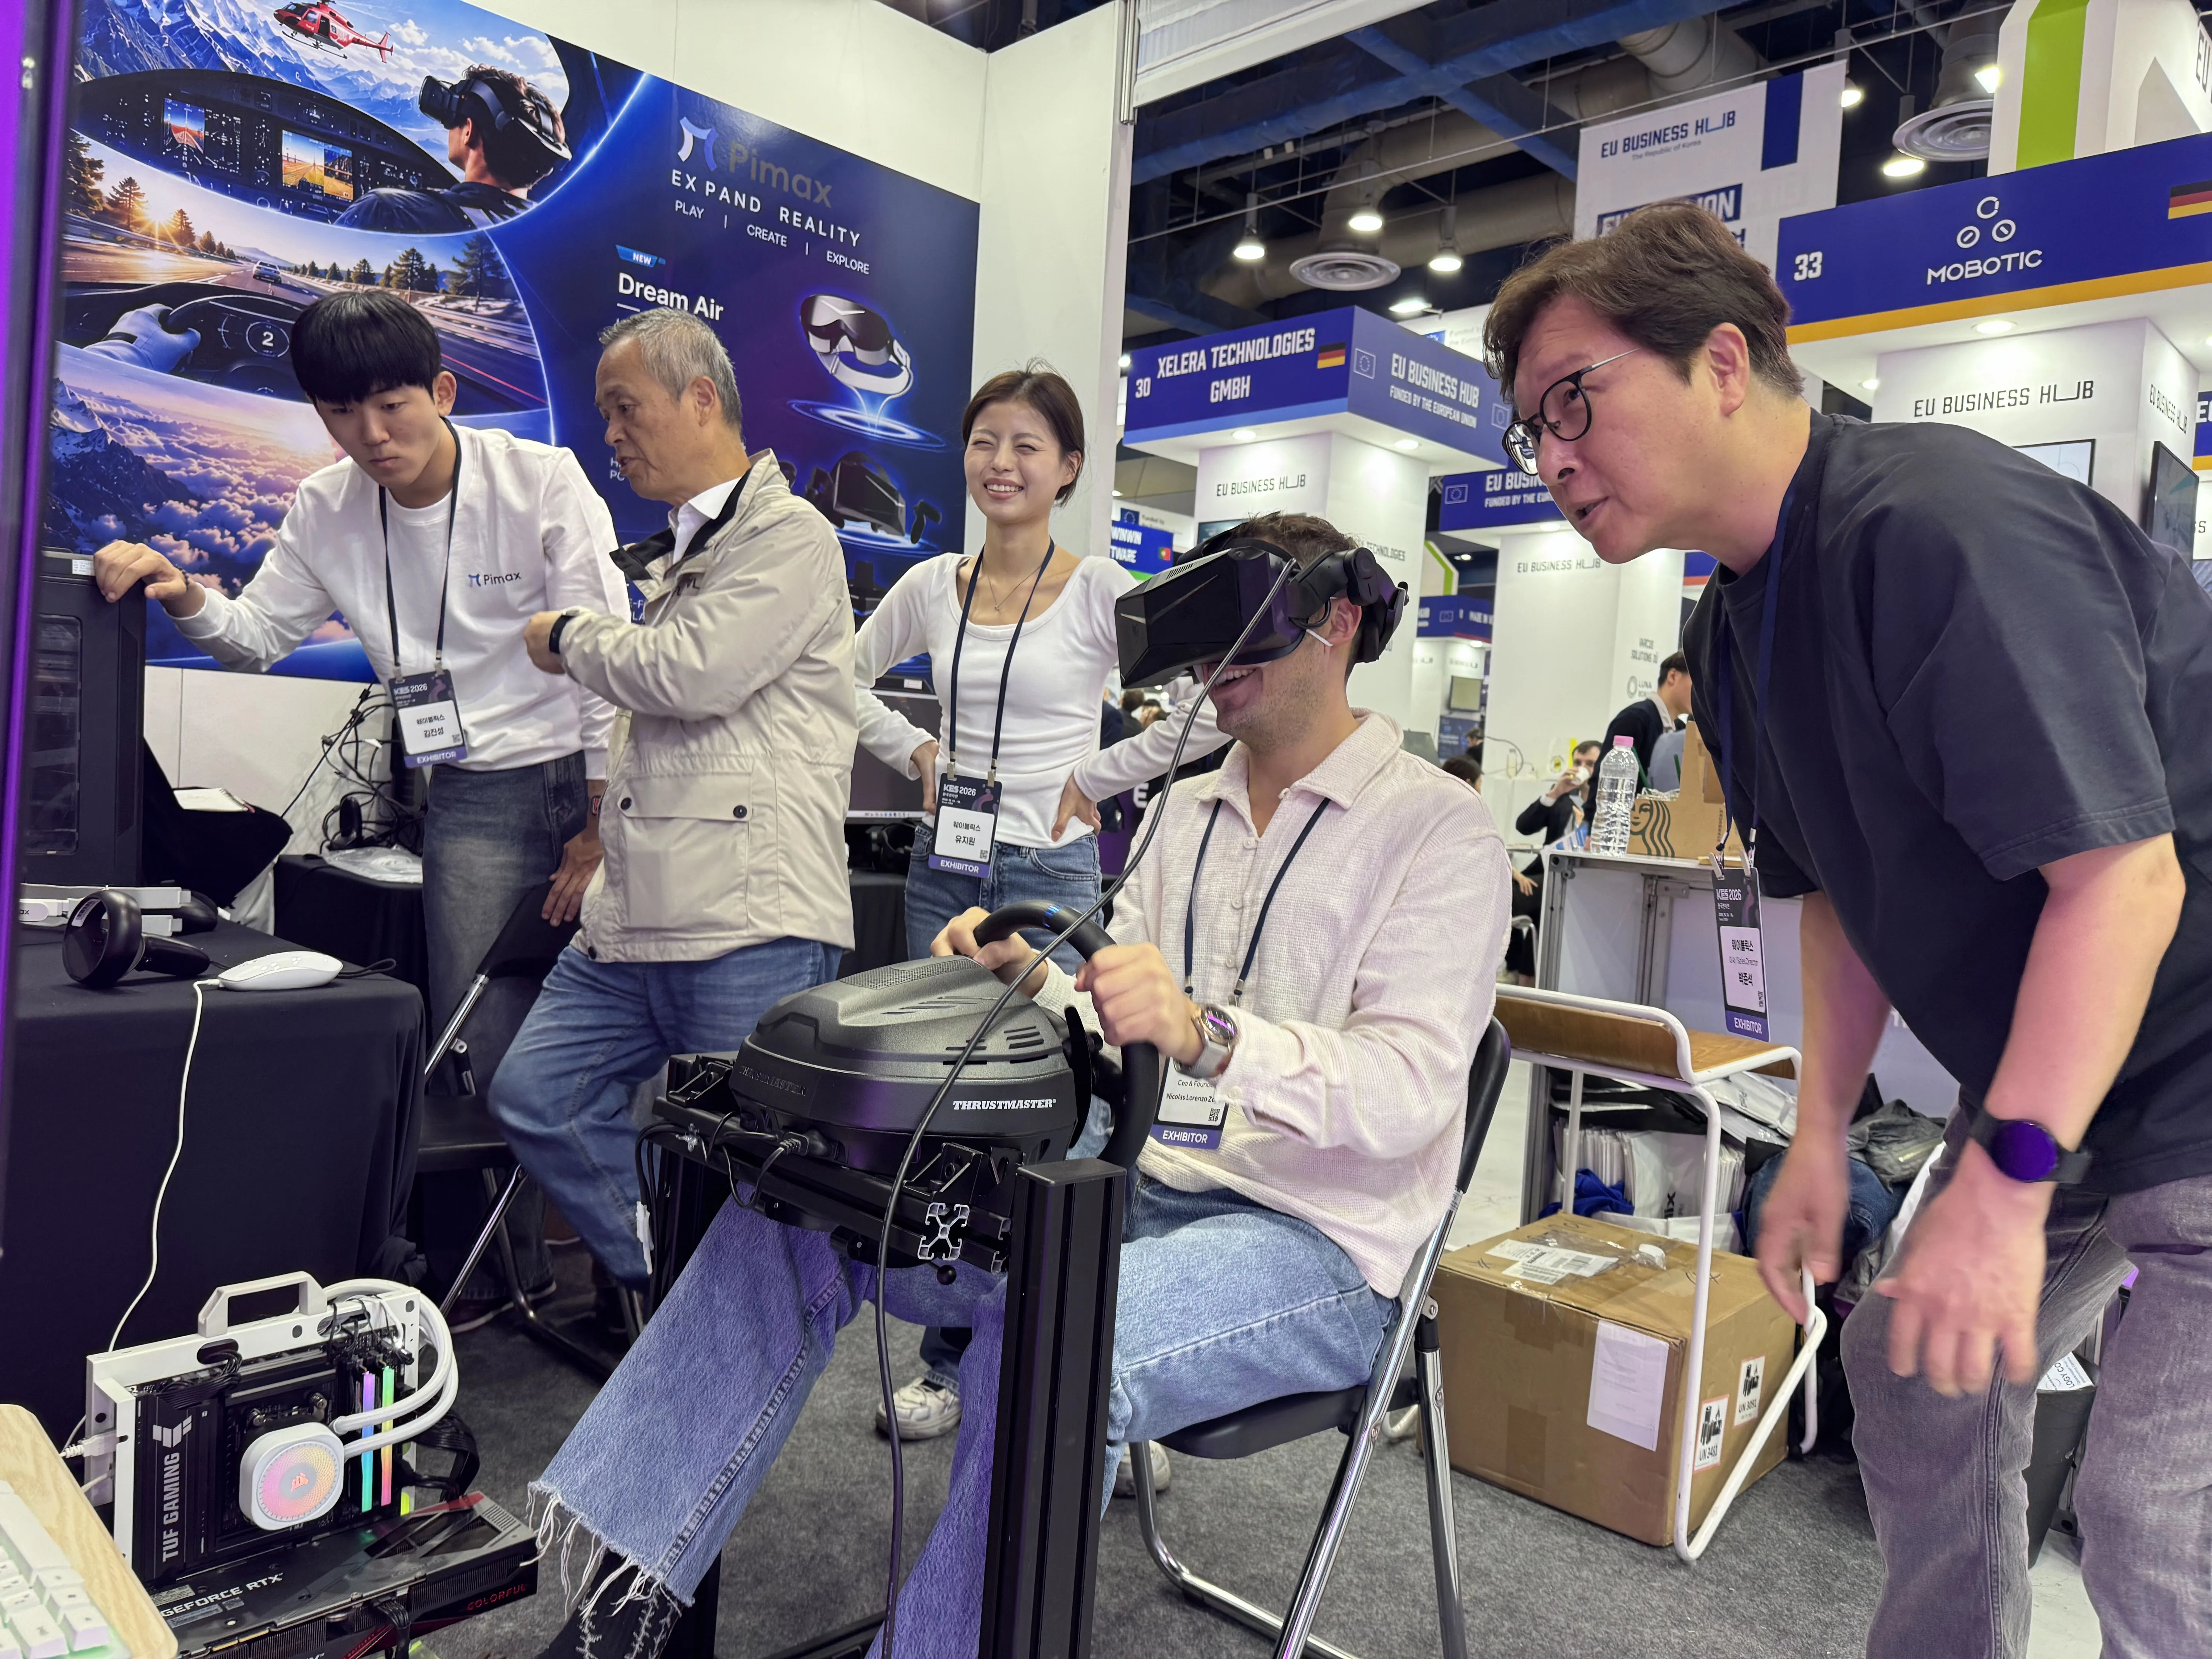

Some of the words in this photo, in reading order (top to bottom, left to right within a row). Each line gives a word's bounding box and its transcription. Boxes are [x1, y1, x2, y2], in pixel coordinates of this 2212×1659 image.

[1601, 140, 1618, 158] EU
[1622, 123, 1688, 153] BUSINESS
[1695, 110, 1736, 136] HUB
[1645, 147, 1673, 158] Republic
[1682, 140, 1702, 149] Korea
[729, 140, 833, 208] Pimax
[672, 169, 761, 213] EXPAND
[779, 207, 860, 247] REALITY
[675, 200, 704, 220] PLAY
[747, 225, 787, 247] CREATE
[826, 251, 869, 275] EXPLORE
[633, 252, 651, 265] NEW
[1794, 251, 1822, 281] 33
[1927, 249, 2042, 285] MOBOTIC
[618, 272, 689, 311] Dream
[694, 295, 724, 321] Air
[262, 331, 273, 347] 2
[1157, 349, 1207, 379] XELERA
[1211, 328, 1315, 369] TECHNOLOGIES
[1135, 377, 1151, 399] 30
[1210, 375, 1251, 403] GMBH
[1391, 353, 1407, 380] EU
[1407, 360, 1458, 400] BUSINESS
[1459, 381, 1480, 408] HUB
[1390, 385, 1412, 404] FUNDED
[1412, 393, 1422, 407] BY
[1421, 397, 1432, 412] THE
[1433, 401, 1460, 422] EUROPEAN
[1460, 412, 1477, 428] UNION
[1914, 398, 1935, 417] EU
[1943, 388, 2030, 414] BUSINESS
[2040, 380, 2094, 404] HUB
[1217, 484, 1228, 496] EU
[1231, 478, 1274, 495] BUSINESS
[1279, 474, 1306, 489] HUB
[1486, 474, 1502, 492] EU
[1505, 471, 1546, 490] BUSIN
[1484, 495, 1511, 508] FUNDED
[1512, 495, 1522, 505] BY
[1523, 493, 1535, 503] THE
[1110, 545, 1137, 563] TWARE
[1517, 562, 1528, 573] EU
[1531, 560, 1571, 572] BUSINESS
[1576, 558, 1601, 569] HUB
[484, 572, 521, 585] Pimax
[410, 683, 428, 693] 2026
[417, 751, 456, 764] EXHIBITOR
[943, 784, 959, 793] KES
[959, 787, 976, 796] 2026
[953, 821, 981, 831] 웨이블릭스
[955, 835, 975, 846] 유지원
[941, 860, 979, 873] EXHIBITOR
[1716, 889, 1729, 900] KES
[1729, 889, 1741, 900] 2026
[1734, 1017, 1762, 1034] EXHIBITOR
[1163, 1130, 1208, 1143] EXHIBITOR
[1739, 1402, 1746, 1413] UN
[1699, 1448, 1707, 1461] UN
[163, 1452, 180, 1525] GAMING
[163, 1528, 179, 1563] TUF
[161, 1587, 243, 1617] GEFORCE
[246, 1575, 282, 1590] RTX
[467, 1584, 526, 1611] COLORFUL
